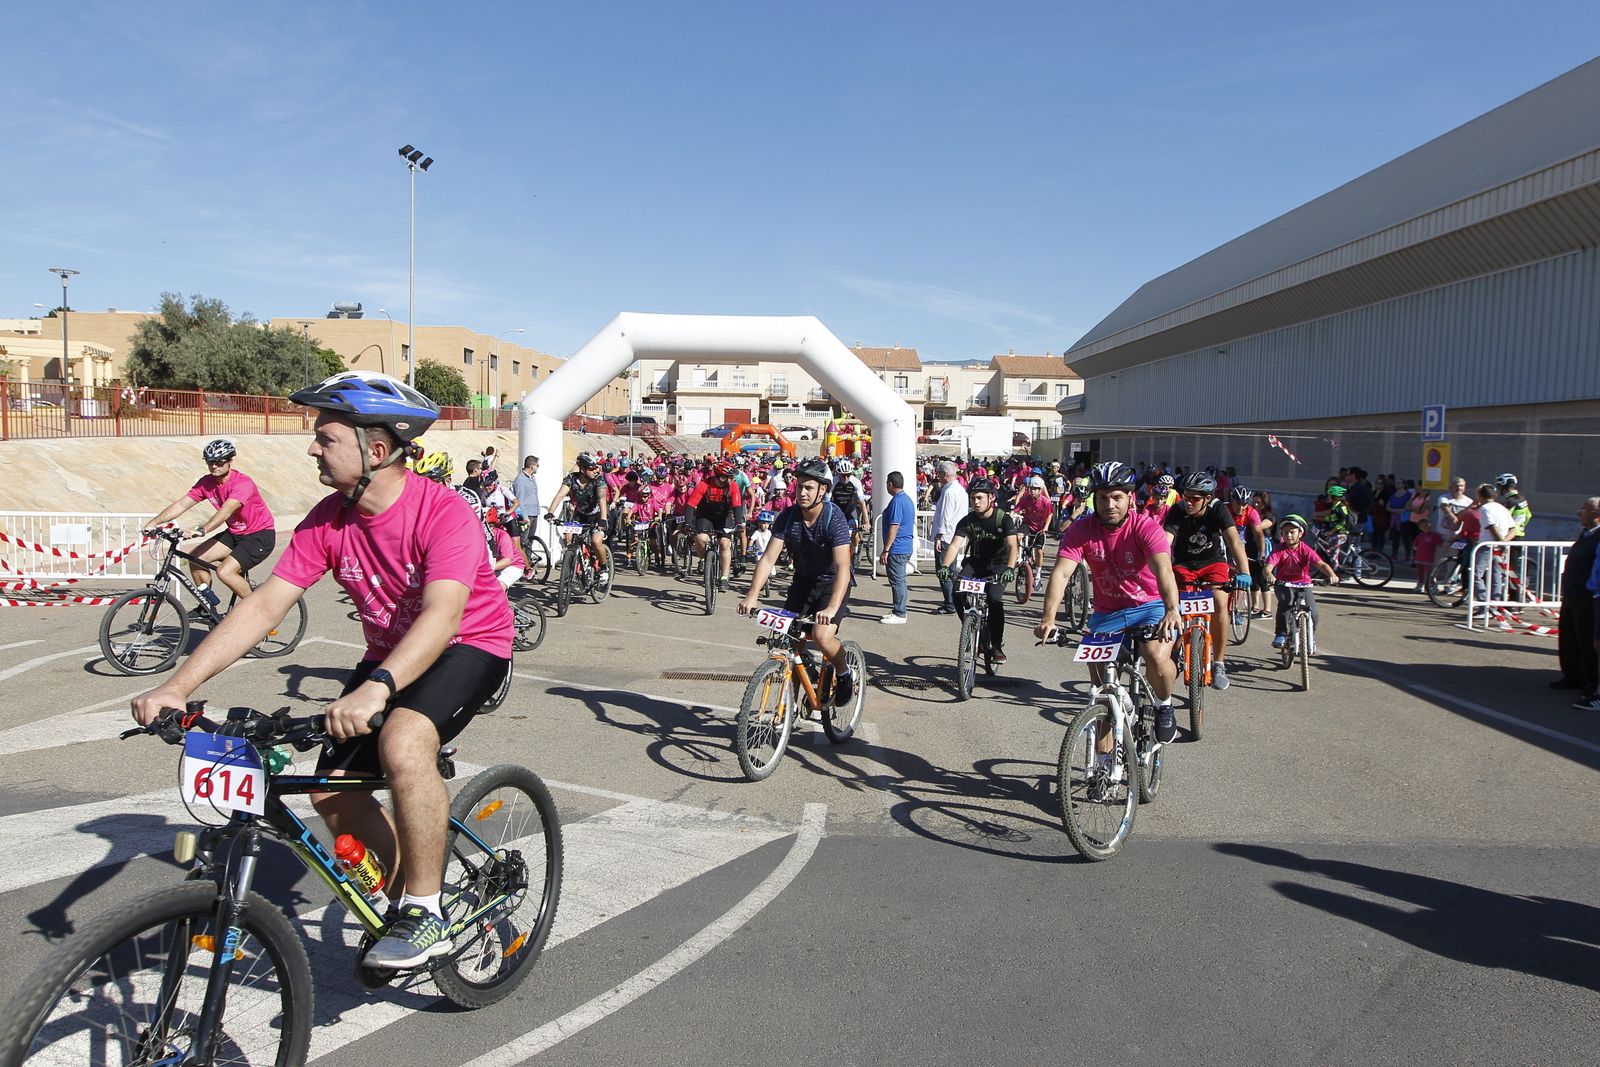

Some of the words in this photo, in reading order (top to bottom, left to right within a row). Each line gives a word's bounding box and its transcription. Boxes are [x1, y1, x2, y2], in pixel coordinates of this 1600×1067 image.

[1425, 410, 1438, 436] P
[962, 581, 981, 592] 155
[1184, 600, 1209, 612] 313
[759, 613, 786, 629] 275
[1079, 646, 1114, 660] 305
[194, 767, 255, 806] 614
